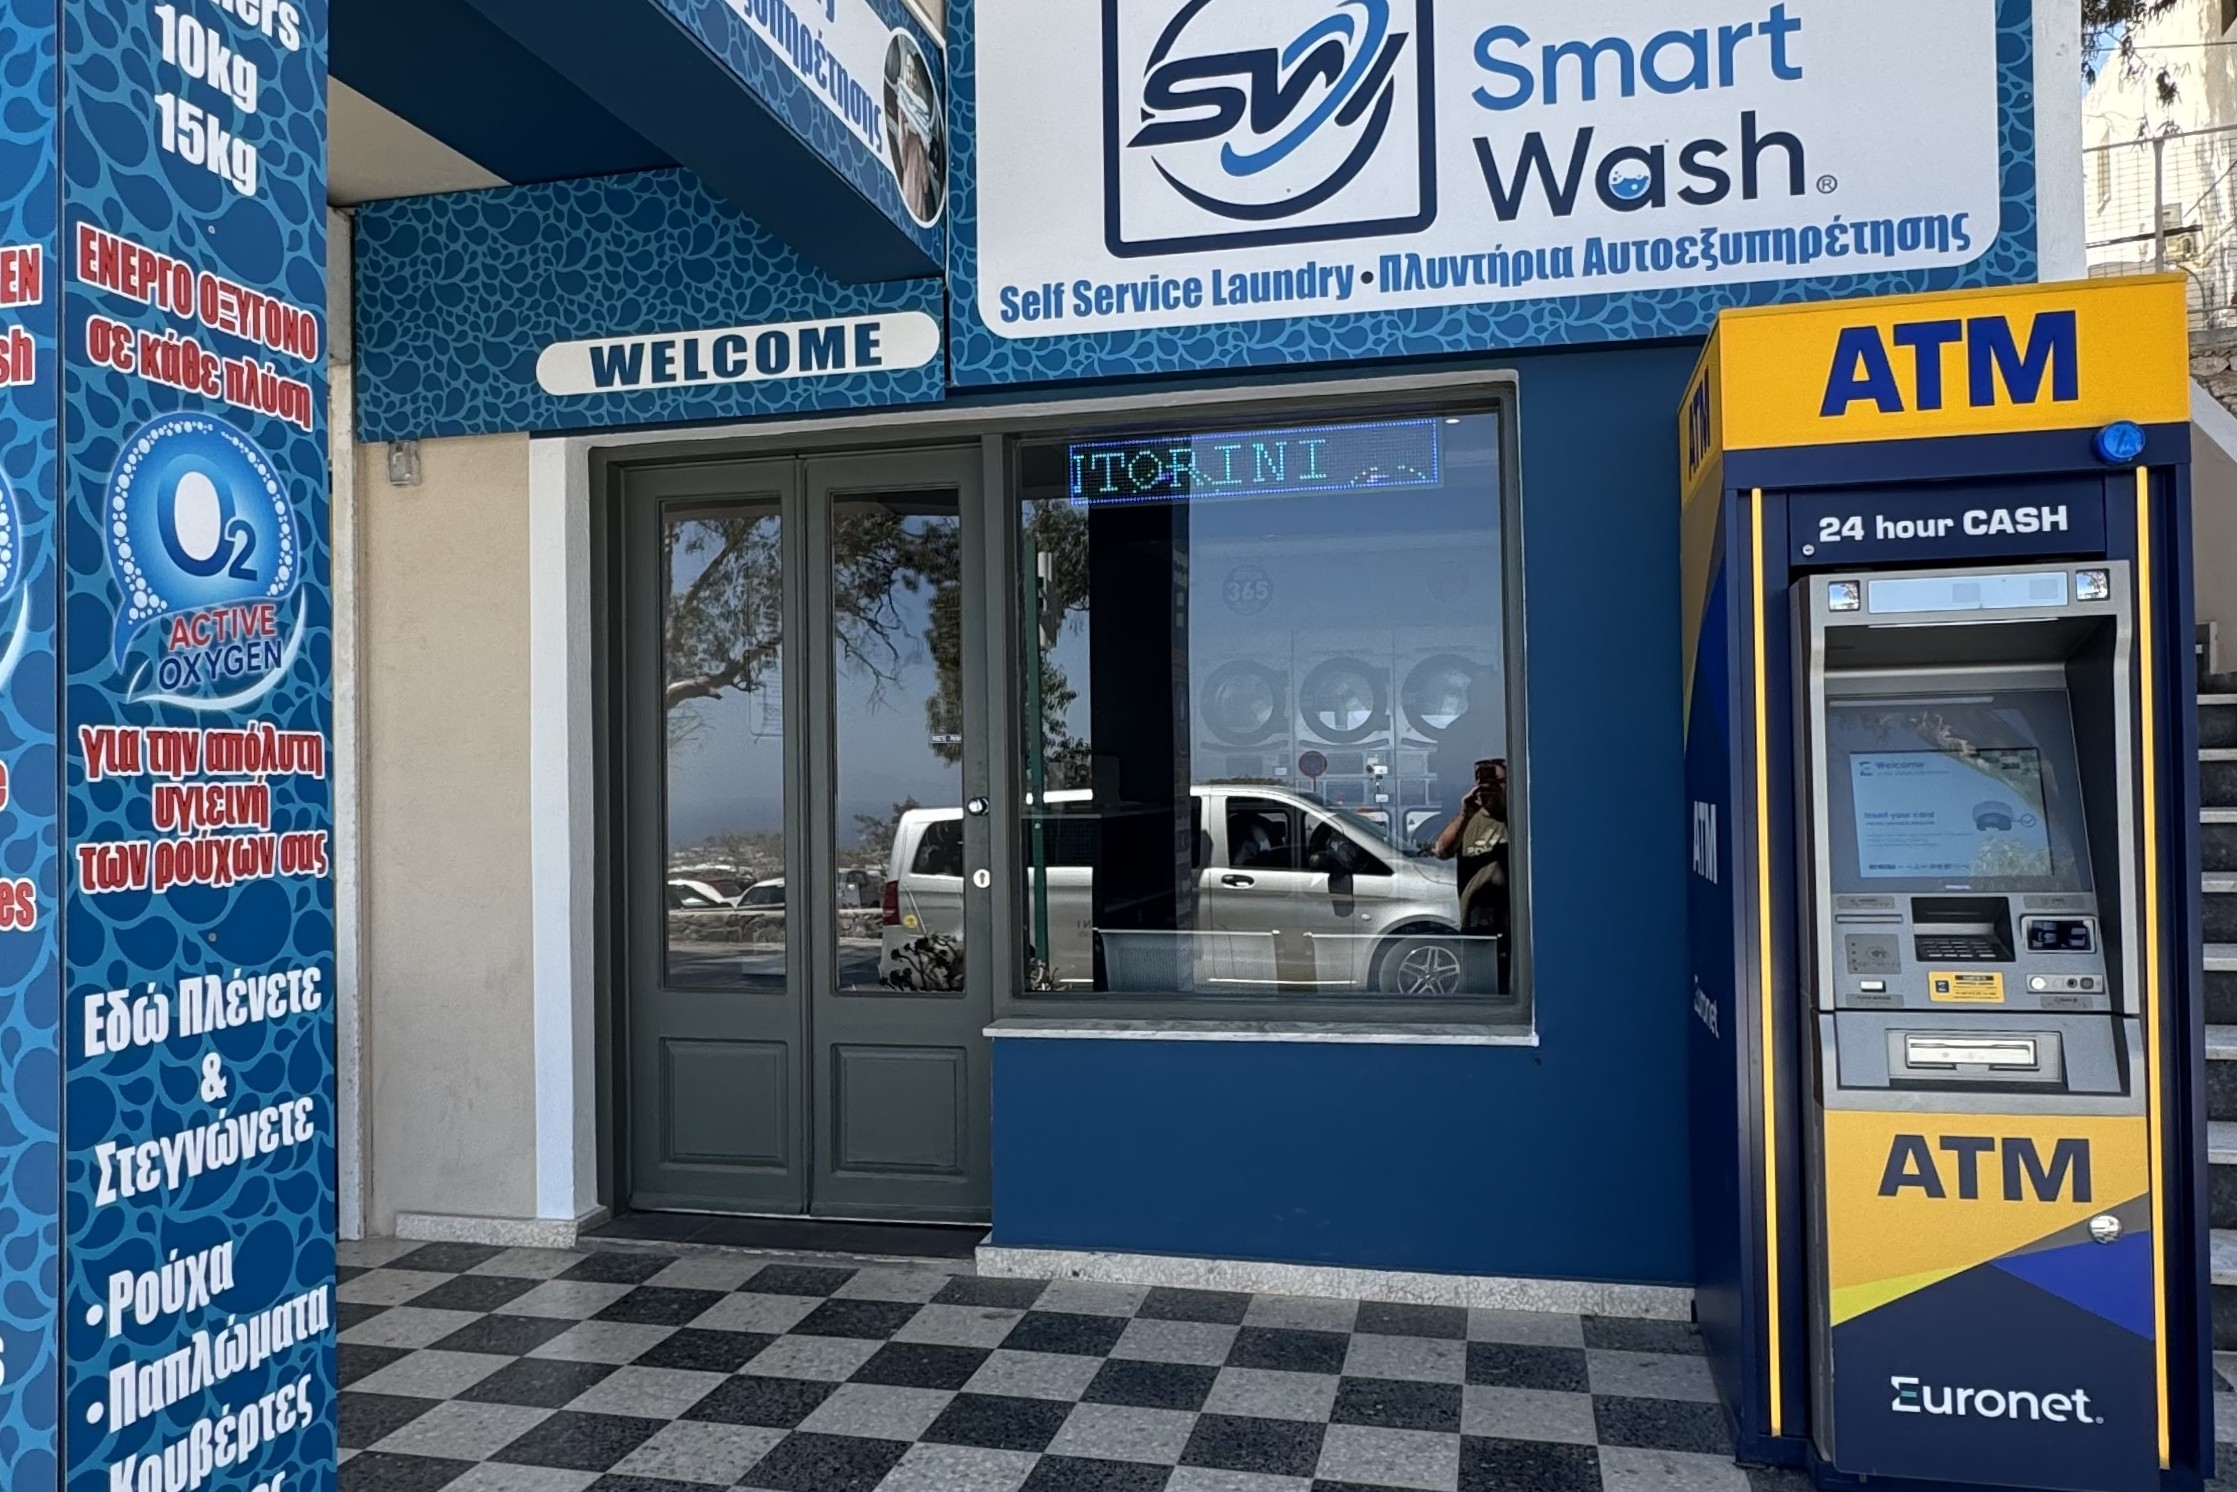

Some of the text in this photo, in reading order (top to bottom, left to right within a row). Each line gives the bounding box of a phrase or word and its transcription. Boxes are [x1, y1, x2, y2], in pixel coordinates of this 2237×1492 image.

[154, 4, 257, 114] 10kg
[1471, 3, 1803, 112] Smart
[154, 92, 257, 197] 15kg
[1472, 110, 1806, 222] Wash
[77, 222, 317, 362] ΕΝΕΡΓΟ ΟΞΥΓΟΝΟ
[1000, 213, 1971, 323] Self Service Laundry Πλυντήρια Αυτοεξυπηρέτησης
[87, 316, 313, 431] σε κάθε πλύση
[590, 322, 883, 388] WELCOME
[1819, 310, 2080, 418] ATM
[1688, 364, 1711, 482] ATM
[1819, 505, 2069, 544] 24 hour CASH
[169, 604, 277, 651] ACTIVE
[1227, 580, 1269, 601] 365
[159, 640, 283, 691] OXYGEN
[80, 721, 325, 780] για την απόλυτη
[153, 777, 270, 831] υγιεινή
[1693, 800, 1718, 885] ATM
[80, 830, 327, 893] των ρούχων σας
[84, 966, 322, 1058] Εδώ Πλένετε
[201, 1053, 227, 1103] &
[95, 1096, 315, 1207] Στεγνώνετε
[1878, 1133, 2093, 1204] ATM
